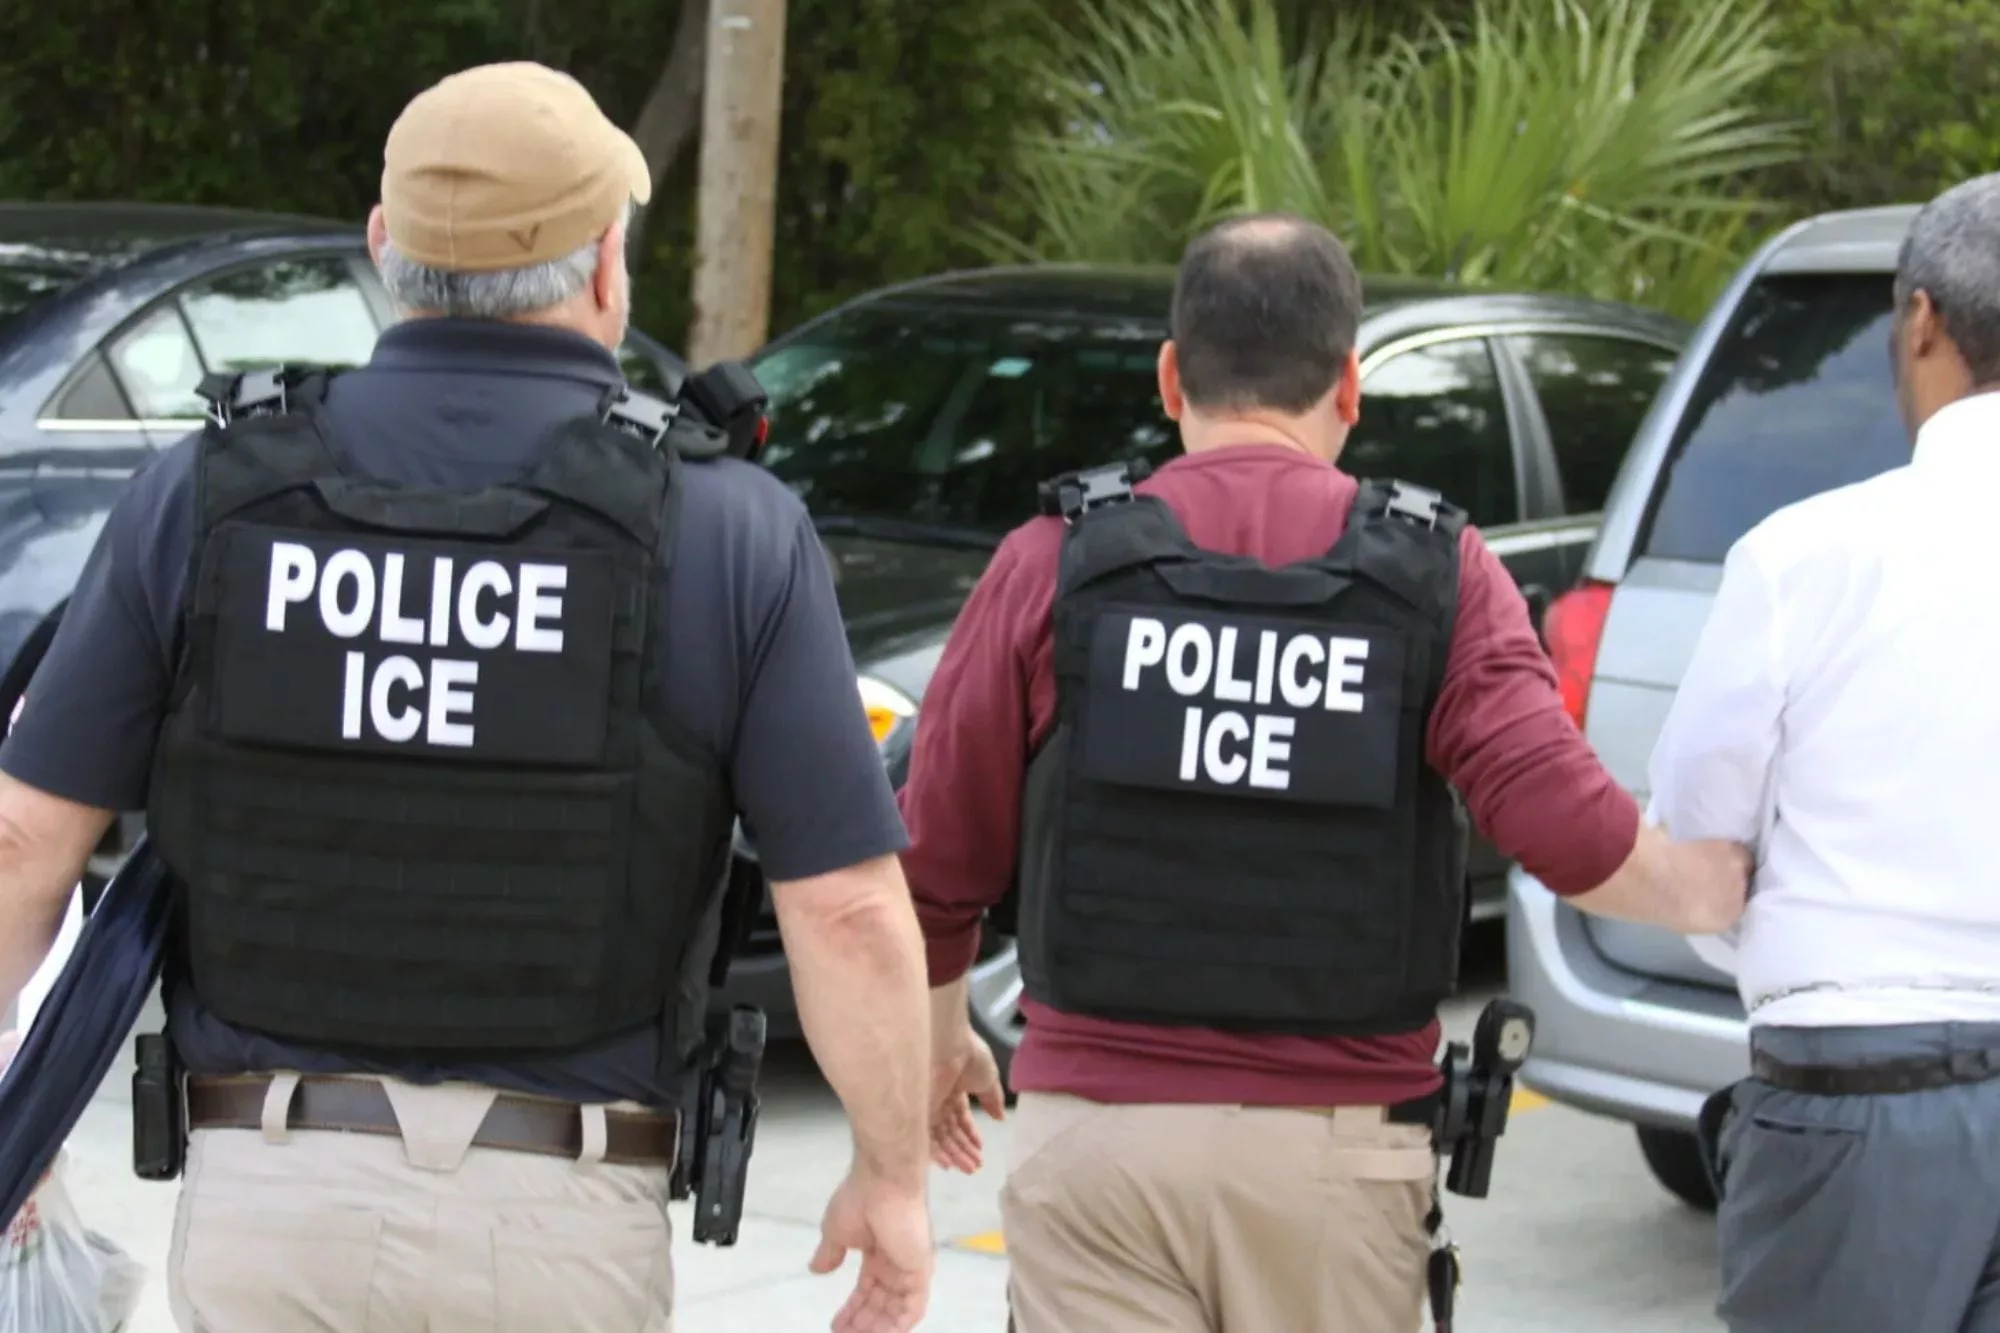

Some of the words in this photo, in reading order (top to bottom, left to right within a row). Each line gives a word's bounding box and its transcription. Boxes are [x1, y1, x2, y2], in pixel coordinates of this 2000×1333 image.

[266, 541, 568, 653] POLICE
[342, 650, 479, 747] ICE
[1122, 616, 1370, 713] POLICE
[1179, 706, 1296, 790] ICE
